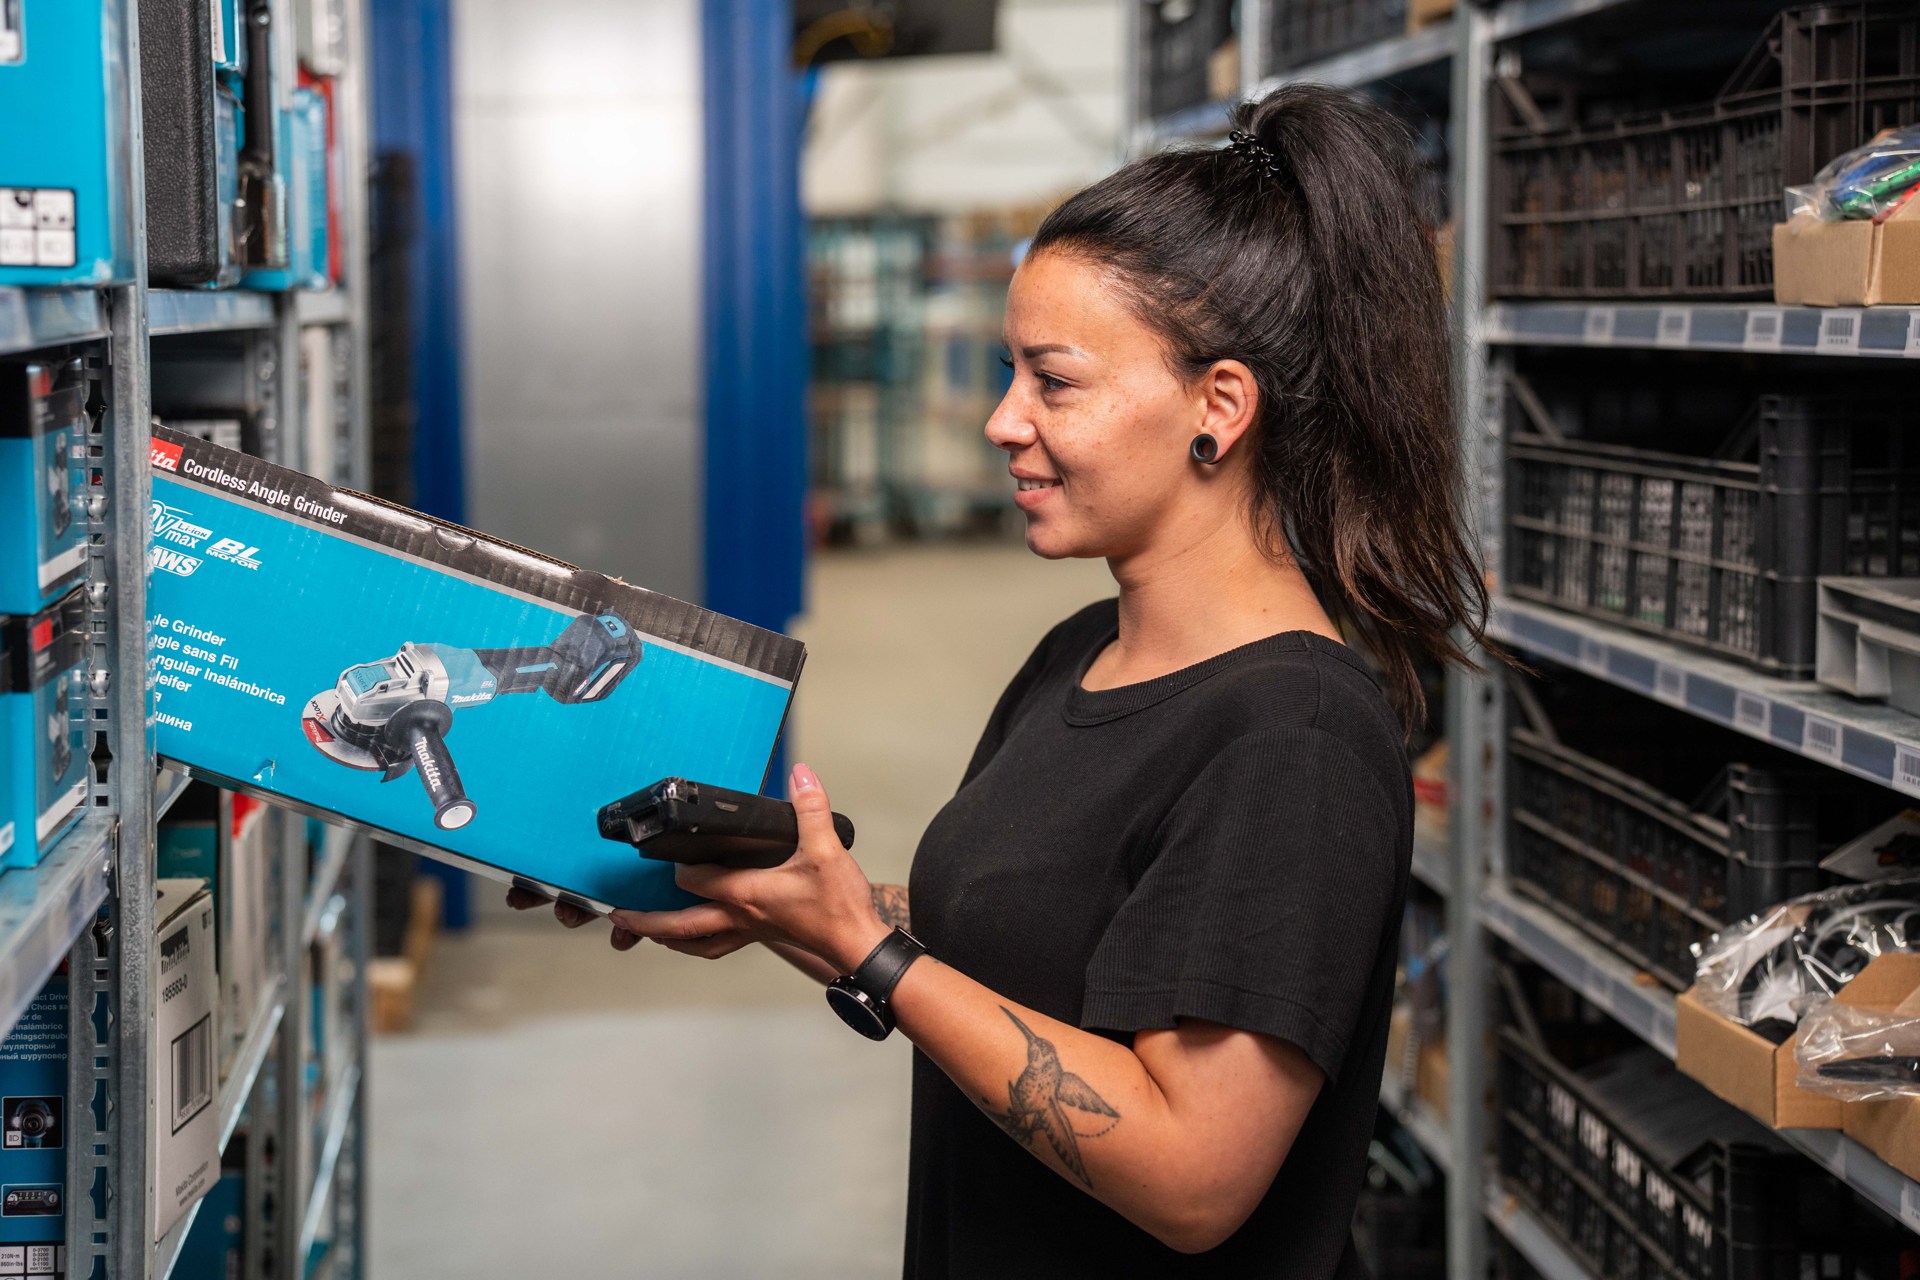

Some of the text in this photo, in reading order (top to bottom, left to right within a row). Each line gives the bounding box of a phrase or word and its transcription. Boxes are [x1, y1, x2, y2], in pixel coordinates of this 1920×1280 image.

[184, 458, 247, 491] Cordless
[248, 480, 290, 504] Angle
[293, 496, 348, 525] Grinder
[205, 549, 259, 571] MOTOR
[210, 537, 261, 559] BL
[172, 619, 227, 647] Grinder
[182, 644, 217, 663] sans
[219, 654, 239, 671] Fil
[155, 654, 287, 706] ngular Inalámbrica
[155, 671, 193, 693] leifer
[155, 710, 193, 732] шина
